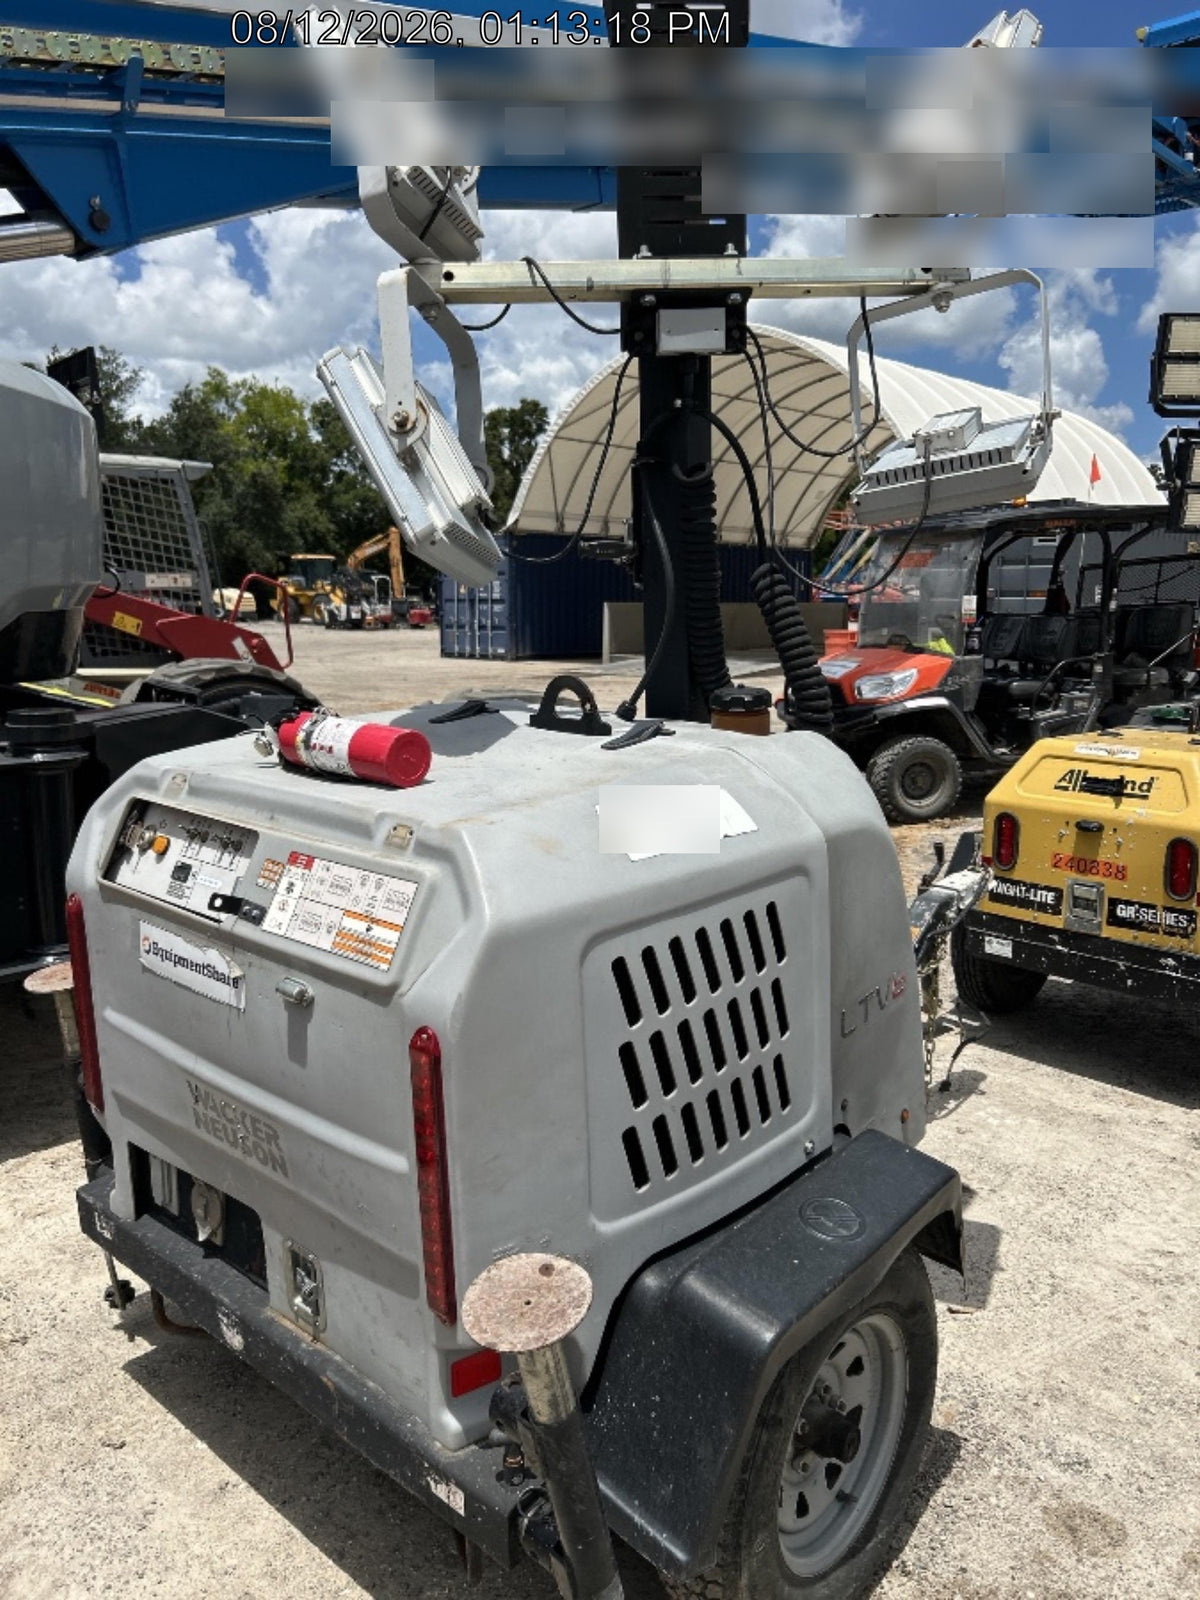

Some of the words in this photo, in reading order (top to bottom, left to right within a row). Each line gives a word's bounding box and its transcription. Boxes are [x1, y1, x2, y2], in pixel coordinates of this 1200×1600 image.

[1054, 769, 1155, 799] Allnd
[1053, 852, 1126, 881] 240838
[152, 941, 239, 989] EquipmentShare
[186, 1079, 284, 1154] WACKER
[193, 1107, 289, 1178] NEUSON
